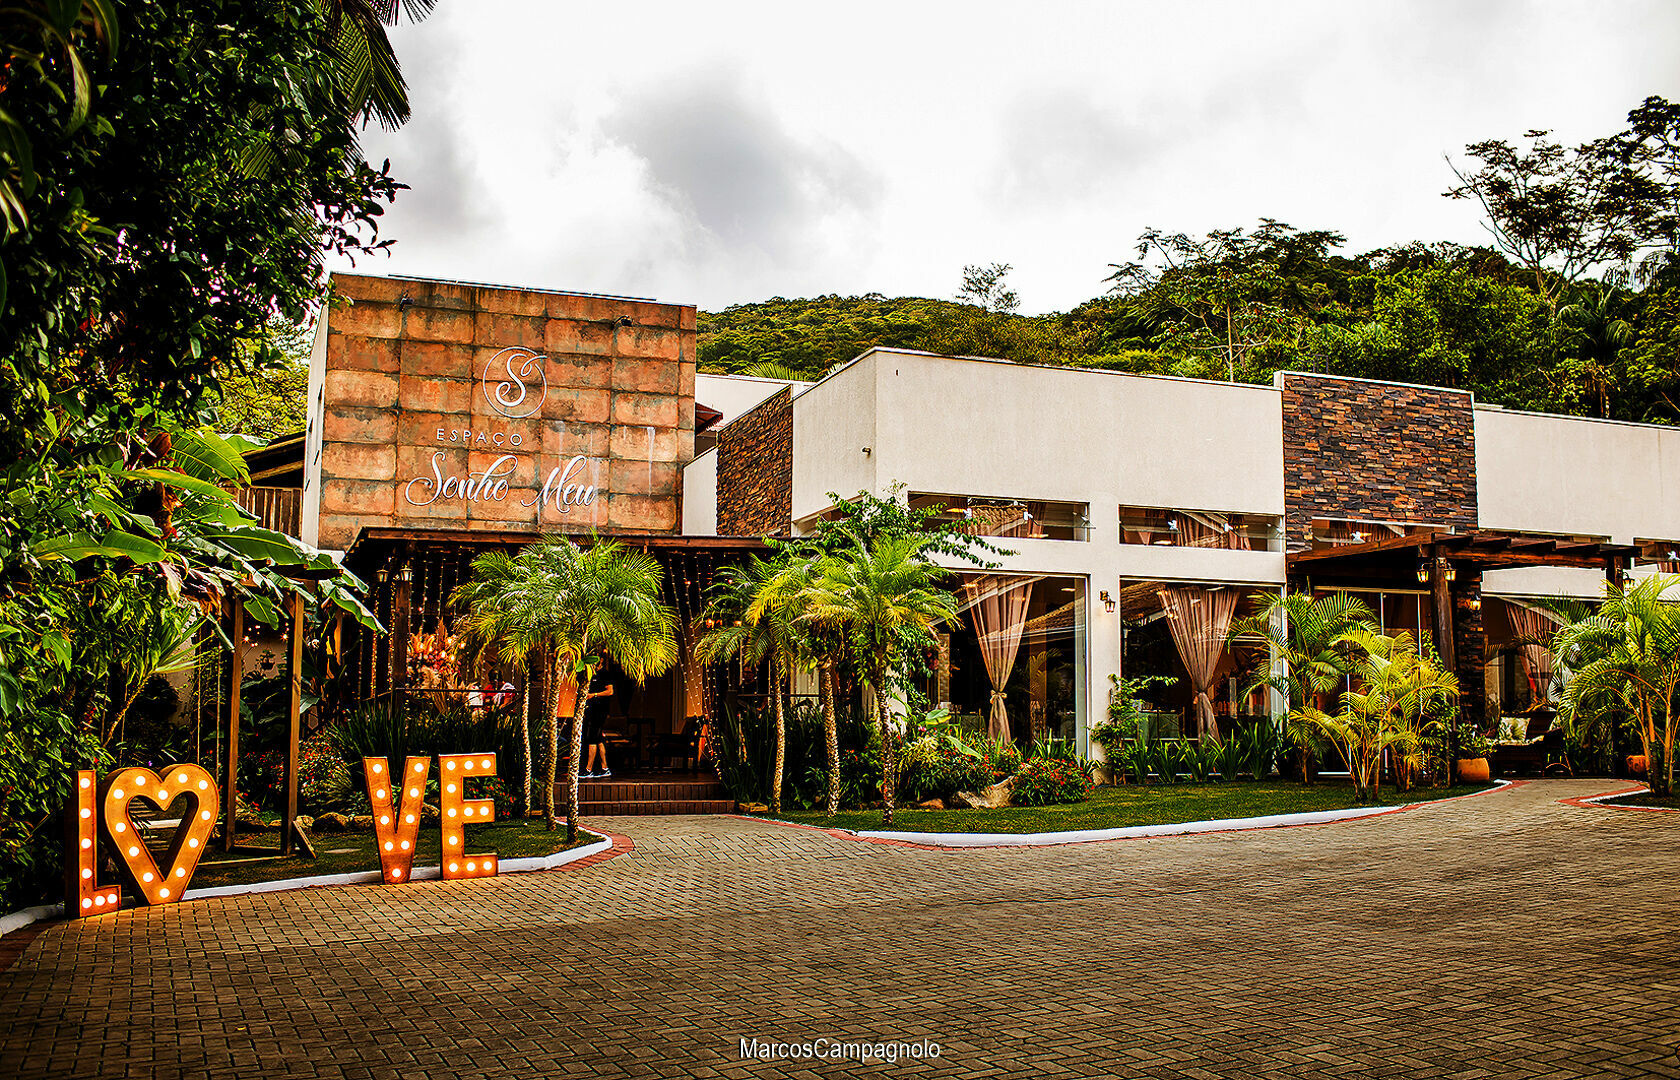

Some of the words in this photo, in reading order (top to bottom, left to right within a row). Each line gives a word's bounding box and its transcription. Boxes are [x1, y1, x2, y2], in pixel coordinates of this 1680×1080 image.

[437, 428, 523, 446] ESPAÇO
[405, 451, 518, 506] Sonho
[520, 455, 596, 513] Meu
